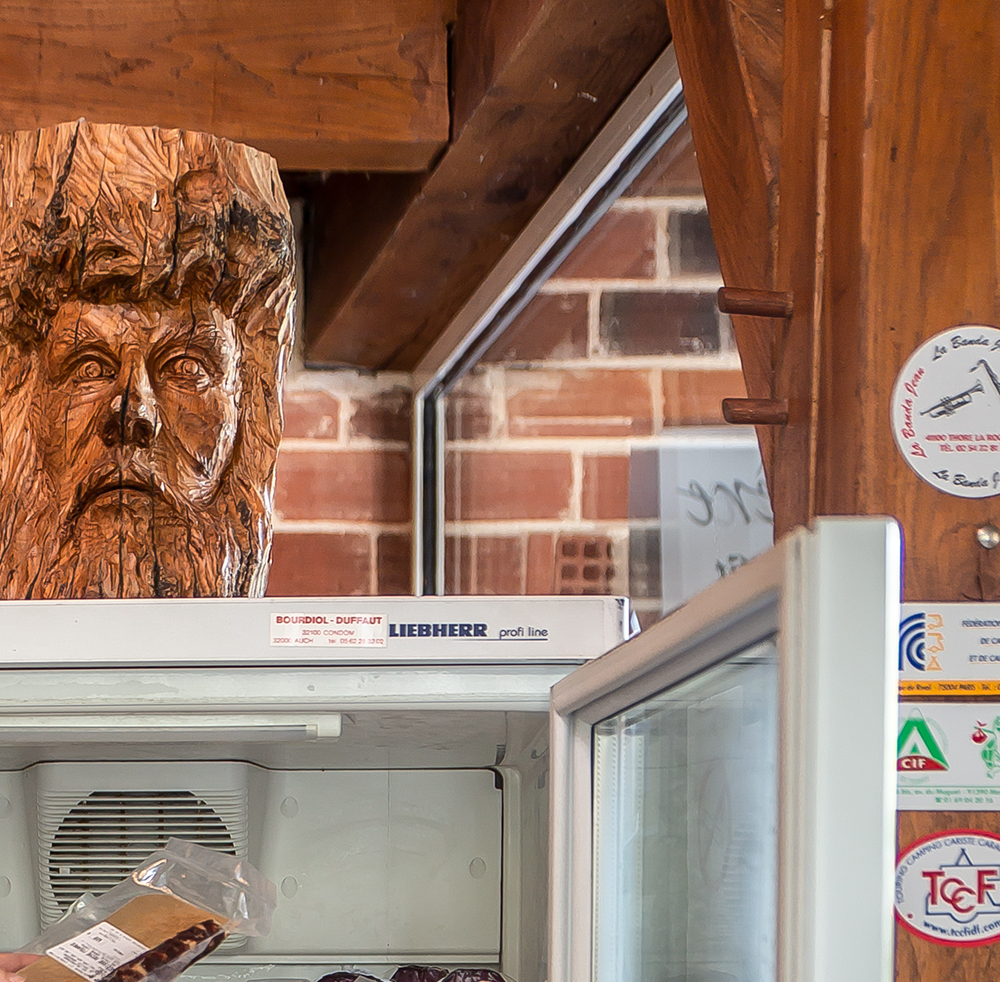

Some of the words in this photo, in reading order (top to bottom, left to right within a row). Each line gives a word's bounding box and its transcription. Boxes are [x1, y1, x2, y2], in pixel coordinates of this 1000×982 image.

[950, 334, 989, 349] Banda
[901, 398, 915, 439] Banda
[953, 473, 988, 487] Banda
[275, 615, 329, 625] BOURDIOL
[336, 616, 383, 626] DUFFAUT
[389, 624, 488, 637] LIEBHERR
[500, 627, 525, 640] profi
[528, 627, 548, 637] line
[980, 637, 989, 645] DE
[978, 654, 988, 662] DE
[901, 758, 926, 769] CIF
[907, 841, 942, 866] CAMPING
